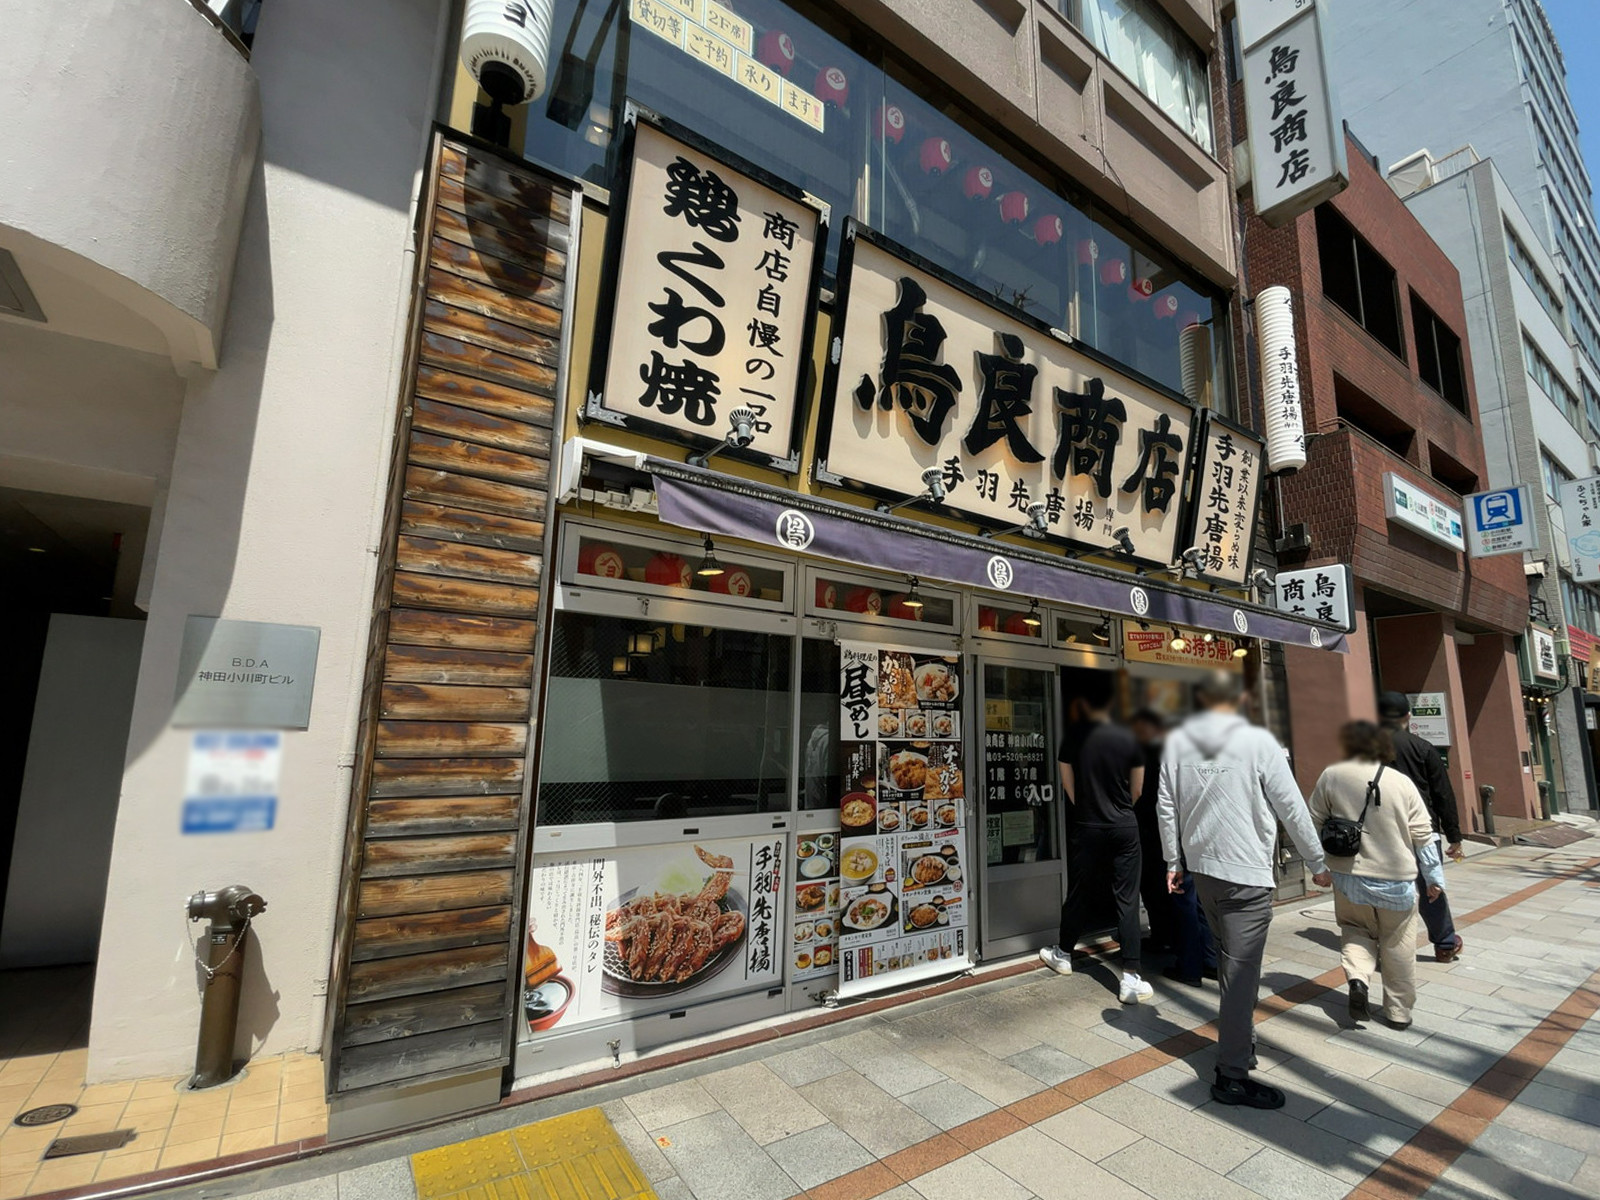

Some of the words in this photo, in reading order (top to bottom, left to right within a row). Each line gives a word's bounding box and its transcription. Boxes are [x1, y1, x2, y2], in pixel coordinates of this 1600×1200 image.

[689, 33, 729, 69] ご予約
[744, 64, 772, 92] 承り
[1265, 45, 1309, 188] 鳥良商店
[739, 211, 799, 443] 商店自慢の一品
[855, 276, 1184, 515] 鳥良商店
[942, 455, 1095, 533] 手羽先唐揚
[1201, 434, 1237, 572] 手羽先唐揚
[1311, 573, 1341, 623] 鳥良
[198, 670, 295, 686] 神田小川町ビル
[231, 657, 269, 669] B.D.A
[1026, 783, 1054, 803] 入口
[587, 857, 606, 974] 門外不出、秘伝のタレ
[749, 845, 772, 974] 手羽先唐揚
